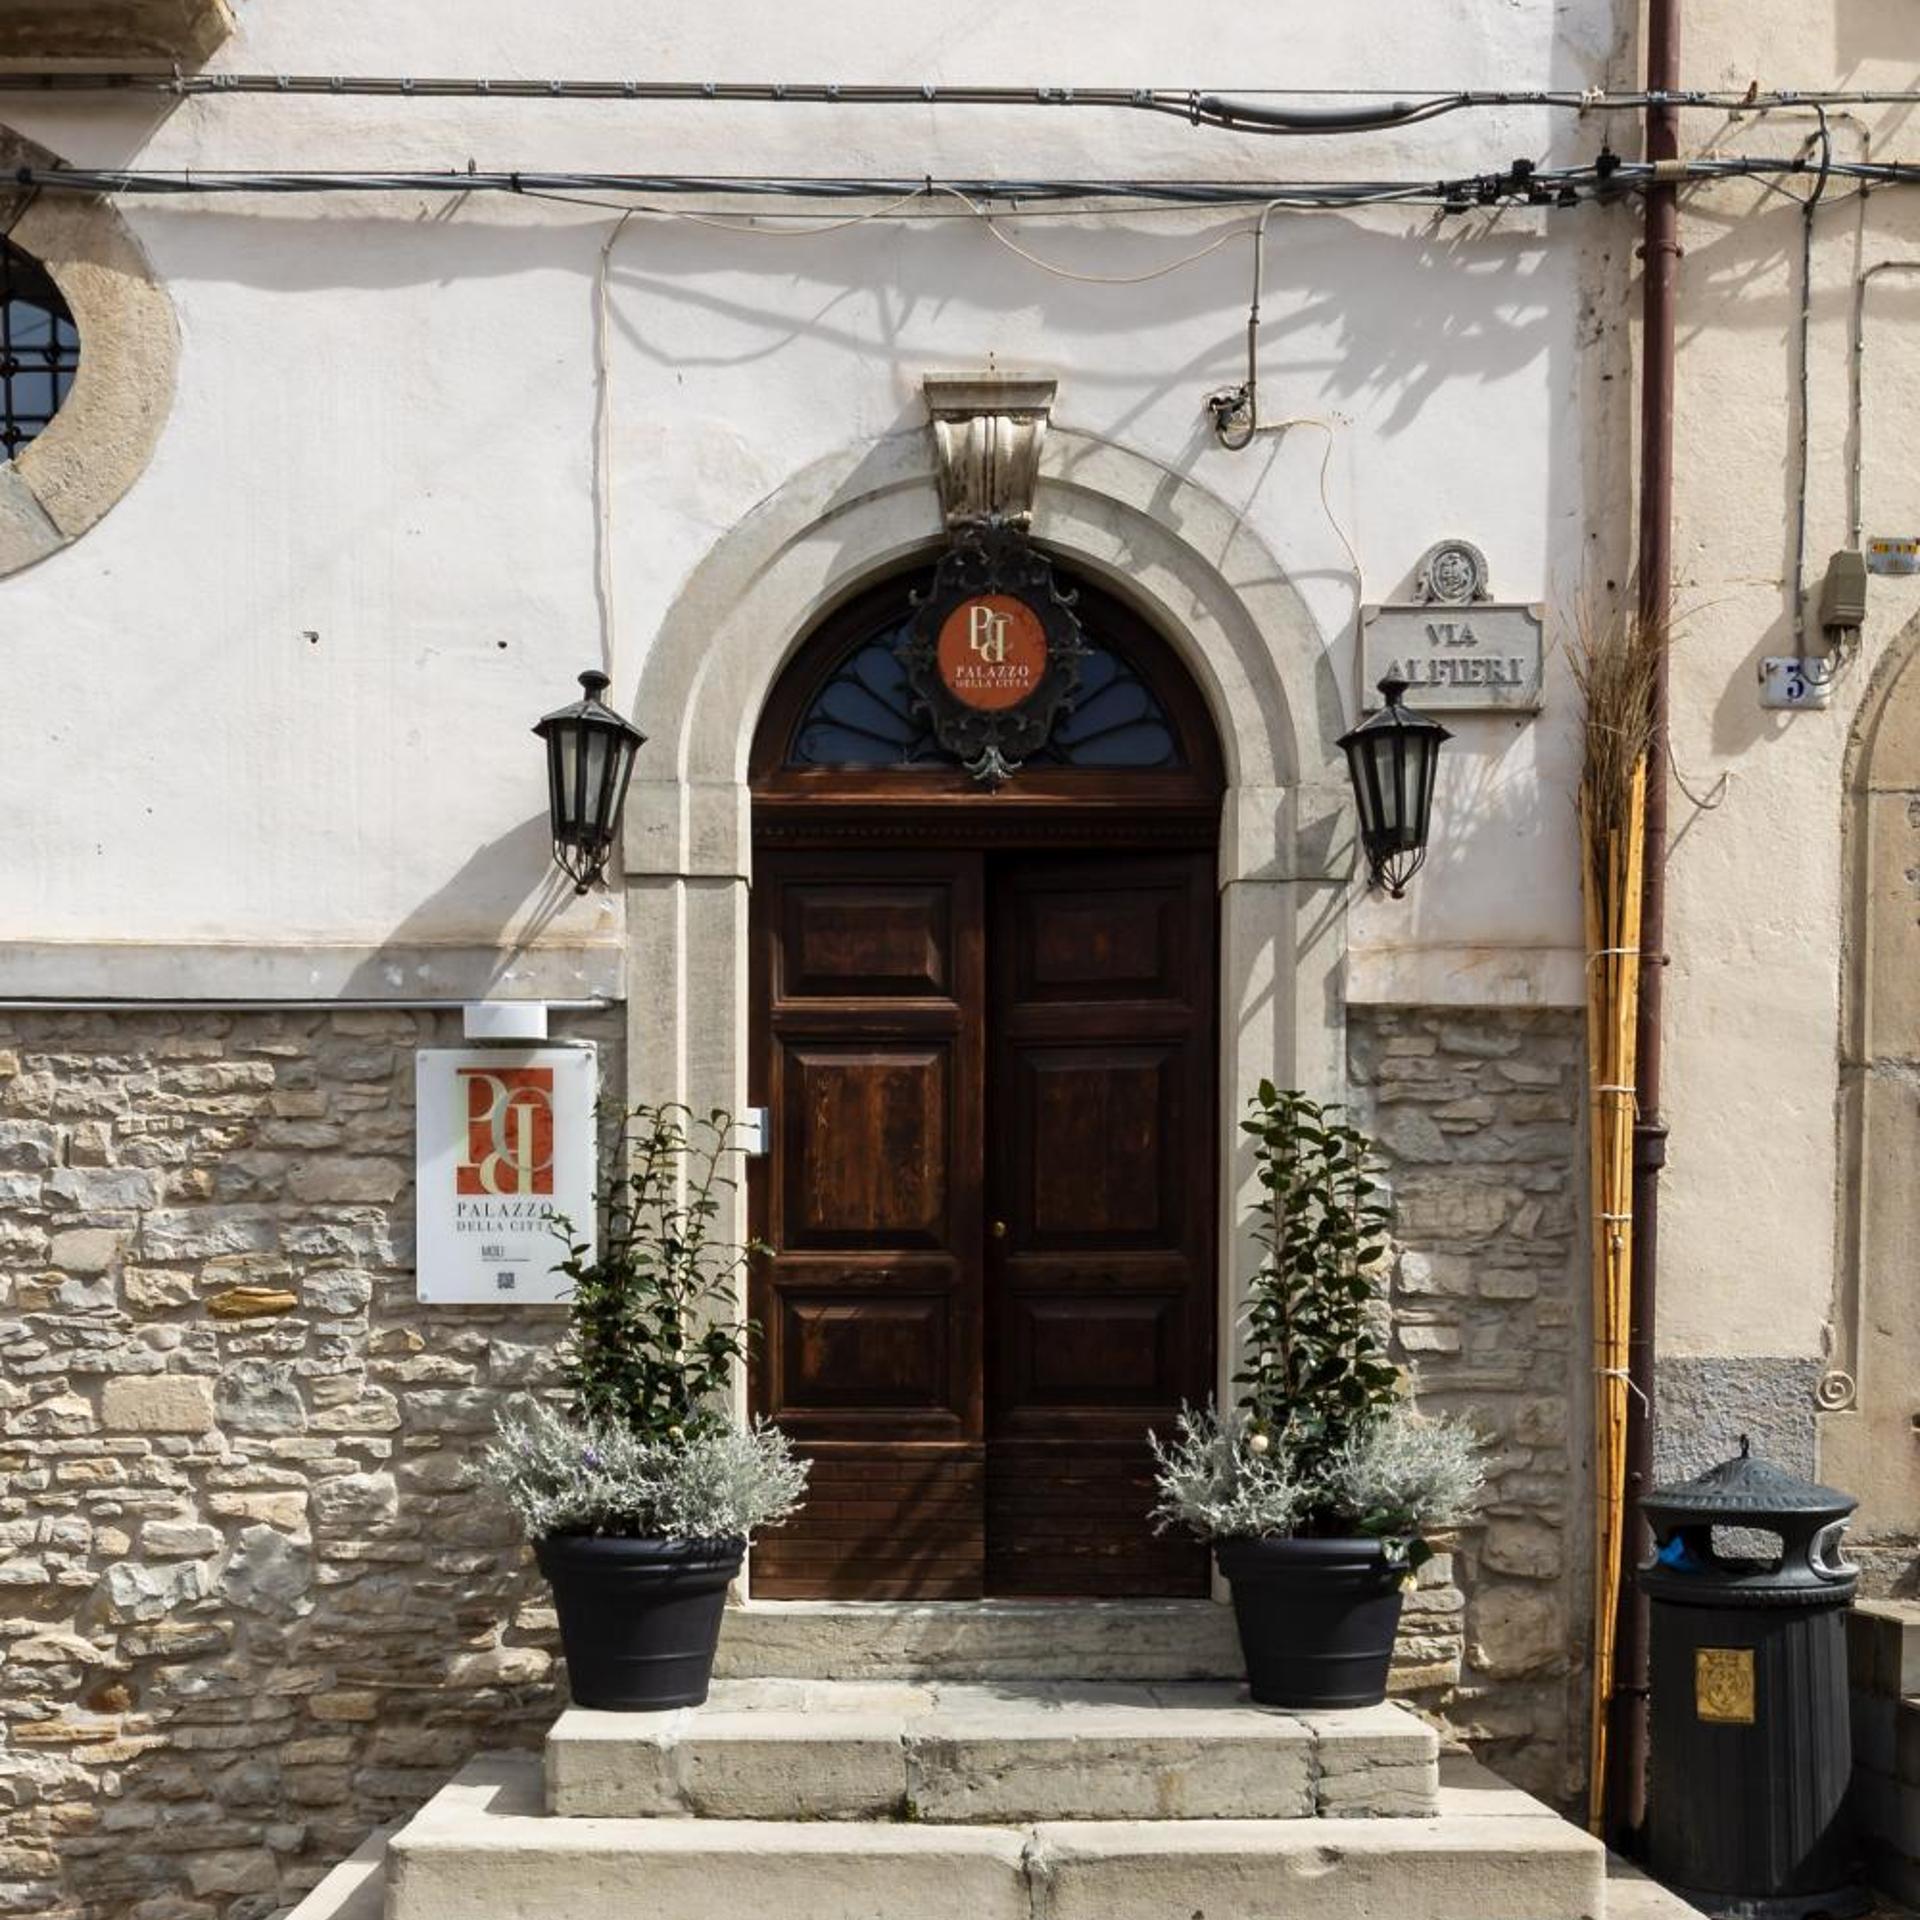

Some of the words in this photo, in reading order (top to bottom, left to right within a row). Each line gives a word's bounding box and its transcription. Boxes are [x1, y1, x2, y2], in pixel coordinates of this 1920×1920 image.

[1425, 623, 1478, 647] VIA
[956, 665, 1030, 678] PALAZZO
[1385, 657, 1524, 688] ALFIERI
[955, 679, 992, 689] DELLA
[1786, 665, 1804, 699] 3
[457, 1202, 554, 1217] PALAZZO
[457, 1220, 503, 1232] DELLA
